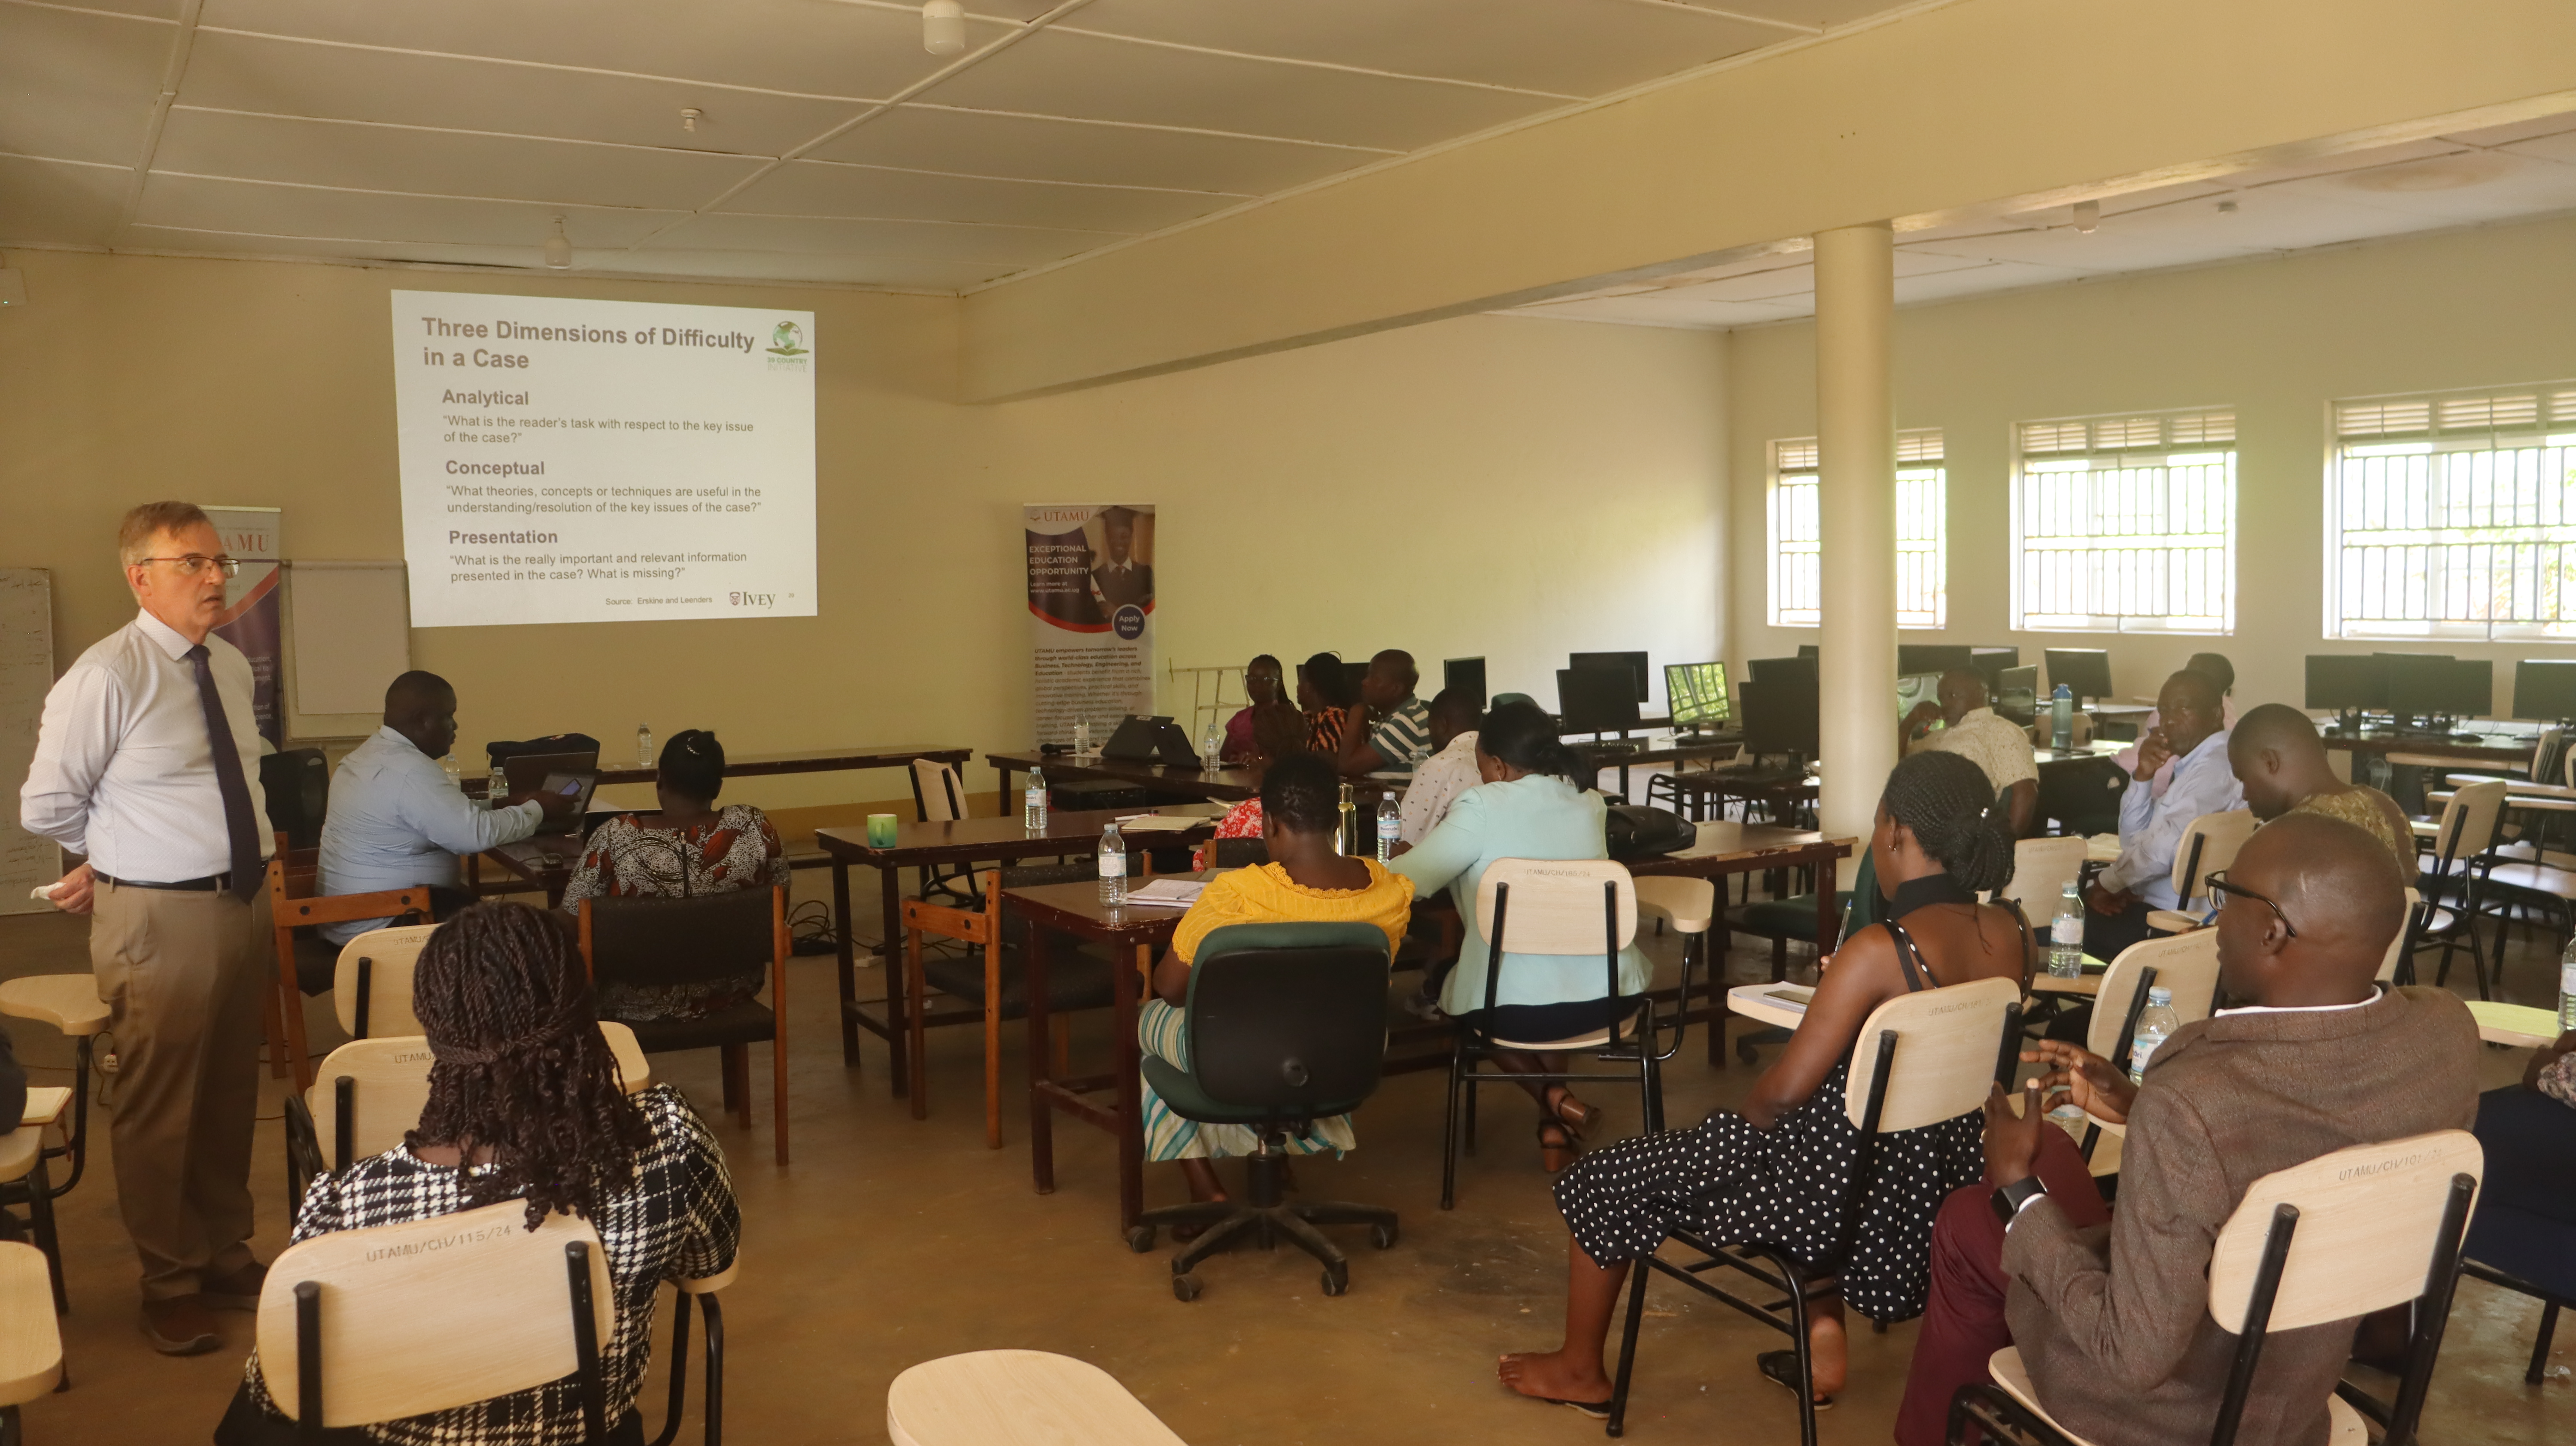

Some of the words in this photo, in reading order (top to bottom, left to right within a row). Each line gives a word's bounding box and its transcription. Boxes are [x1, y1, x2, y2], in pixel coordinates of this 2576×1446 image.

[421, 316, 488, 338] Three
[496, 320, 627, 344] Dimensions
[635, 327, 656, 345] of
[662, 328, 755, 354] Difficulty
[423, 346, 444, 366] in
[453, 352, 465, 367] a
[473, 348, 529, 369] Case
[442, 389, 529, 408] Analytical
[483, 416, 493, 427] is
[497, 416, 515, 427] the
[519, 417, 567, 428] reader's
[571, 418, 595, 428] task
[598, 418, 621, 429] with
[624, 420, 666, 432] respect
[668, 420, 680, 430] to
[683, 420, 700, 431] the
[703, 420, 723, 434] key
[726, 421, 754, 432] issue
[444, 431, 456, 442] of
[459, 431, 478, 443] the
[445, 459, 545, 478] Conceptual
[486, 486, 537, 498] theories,
[541, 486, 593, 498] concepts
[596, 488, 608, 496] or
[611, 486, 672, 499] techniques
[675, 488, 693, 497] are
[696, 486, 729, 497] useful
[732, 486, 741, 497] in
[744, 486, 761, 497] the
[447, 502, 592, 515] understanding/resolution
[595, 501, 607, 513] of
[609, 502, 627, 512] the
[631, 502, 650, 515] key
[653, 502, 689, 512] issues
[692, 501, 703, 512] of
[705, 502, 722, 512] the
[1044, 511, 1089, 522] UTAMU
[223, 534, 270, 553] AMU
[449, 529, 558, 544] Presentation
[489, 555, 499, 565] is
[502, 554, 521, 565] the
[525, 554, 556, 567] really
[560, 553, 613, 566] important
[616, 553, 637, 563] and
[641, 553, 685, 563] relevant
[687, 552, 747, 562] information
[450, 570, 510, 583] presented
[514, 570, 524, 580] in
[527, 570, 546, 580] the
[549, 568, 583, 580] case?
[587, 568, 617, 579] What
[620, 568, 629, 578] is
[1030, 567, 1089, 575] OPPORTUNITY
[366, 1224, 511, 1262] UTAMU/CH/115/24
